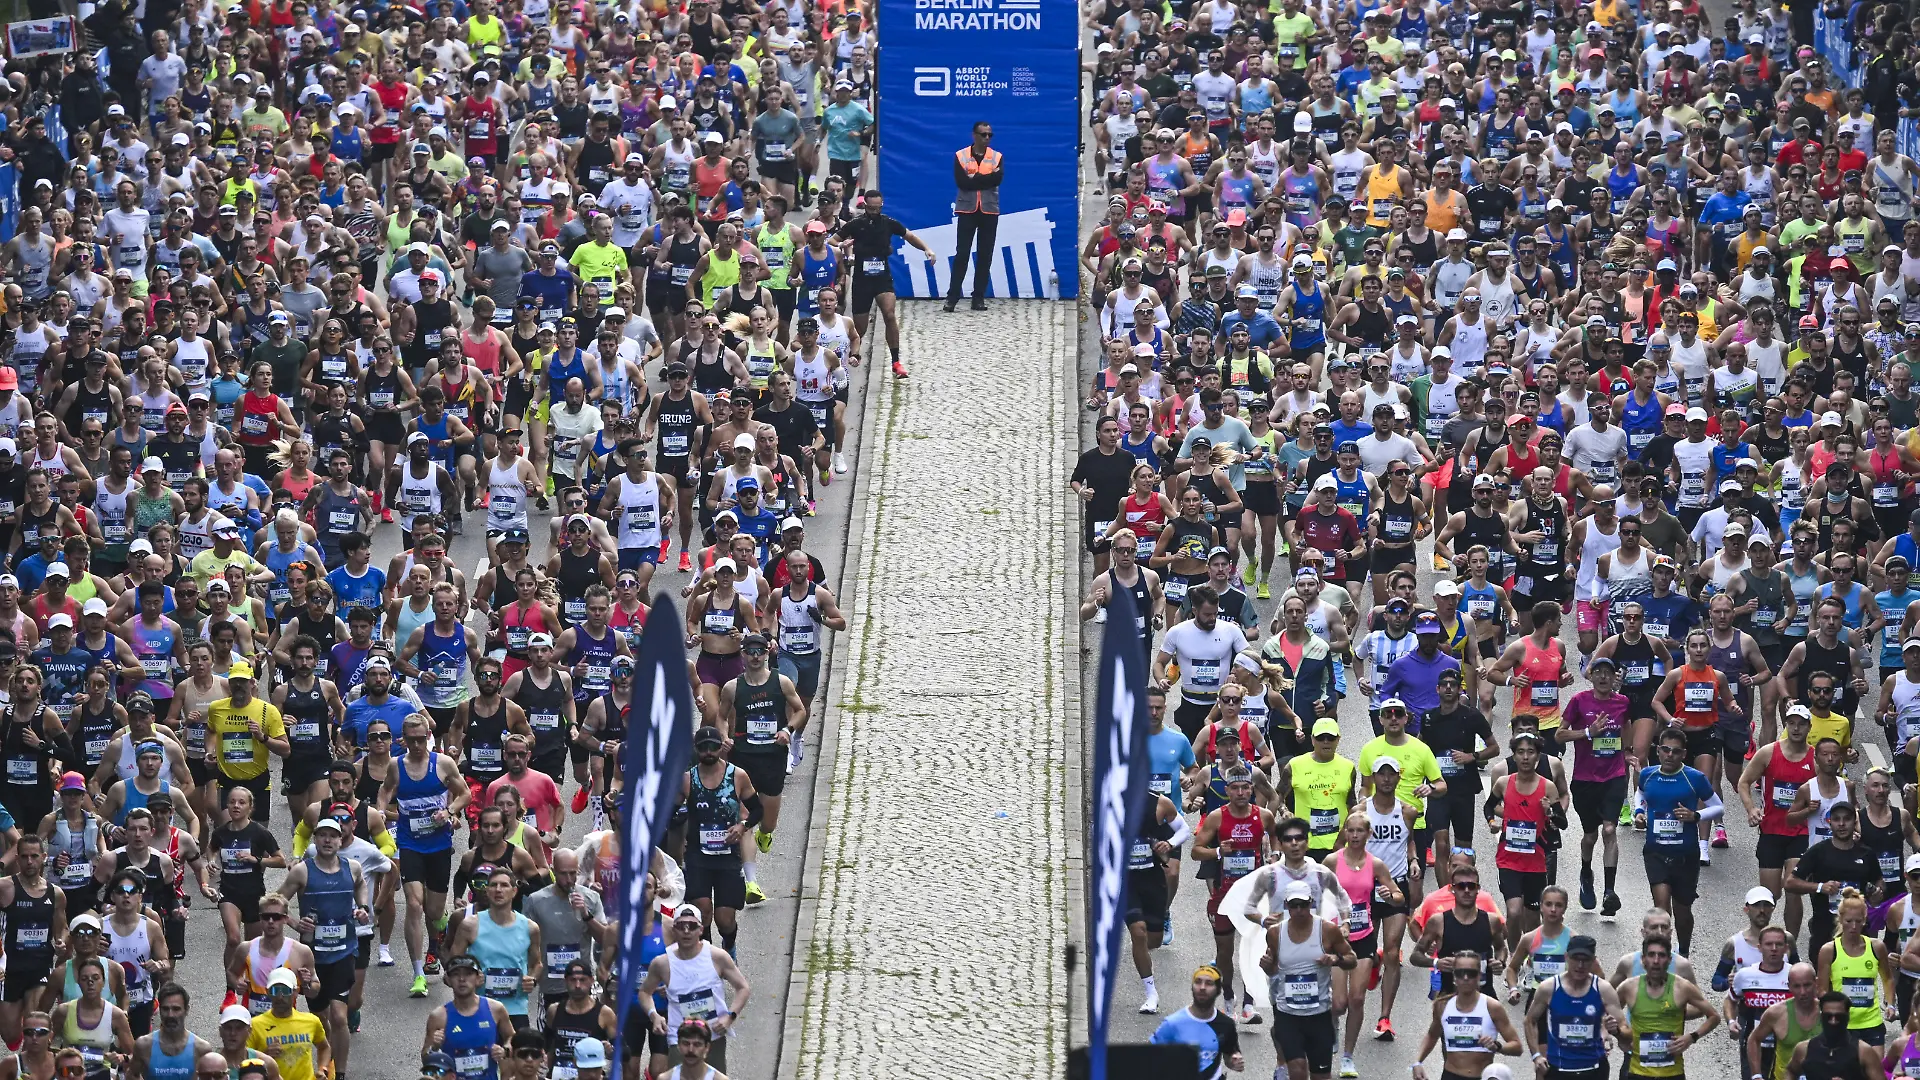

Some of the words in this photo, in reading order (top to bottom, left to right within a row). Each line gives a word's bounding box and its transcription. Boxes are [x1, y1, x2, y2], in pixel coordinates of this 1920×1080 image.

[916, 13, 1041, 30] MARATHON
[1386, 652, 1395, 665] 10
[45, 663, 76, 672] TAIWAN
[84, 723, 112, 733] RUNAWAY
[1372, 825, 1401, 840] NBR
